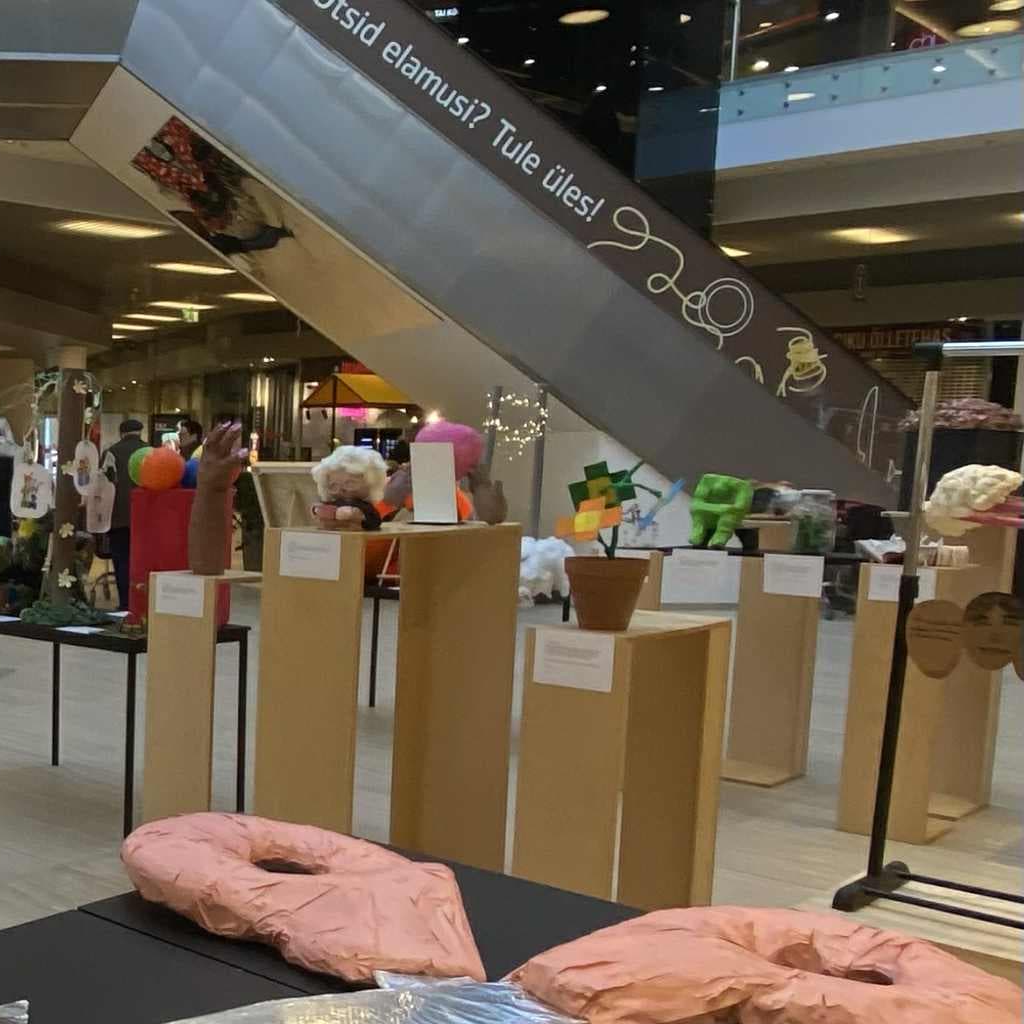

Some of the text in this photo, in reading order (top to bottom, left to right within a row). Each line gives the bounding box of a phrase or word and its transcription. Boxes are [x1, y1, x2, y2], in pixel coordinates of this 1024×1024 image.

[381, 40, 492, 129] elamusi?
[491, 117, 541, 175] Tule
[542, 164, 605, 223] üles!
